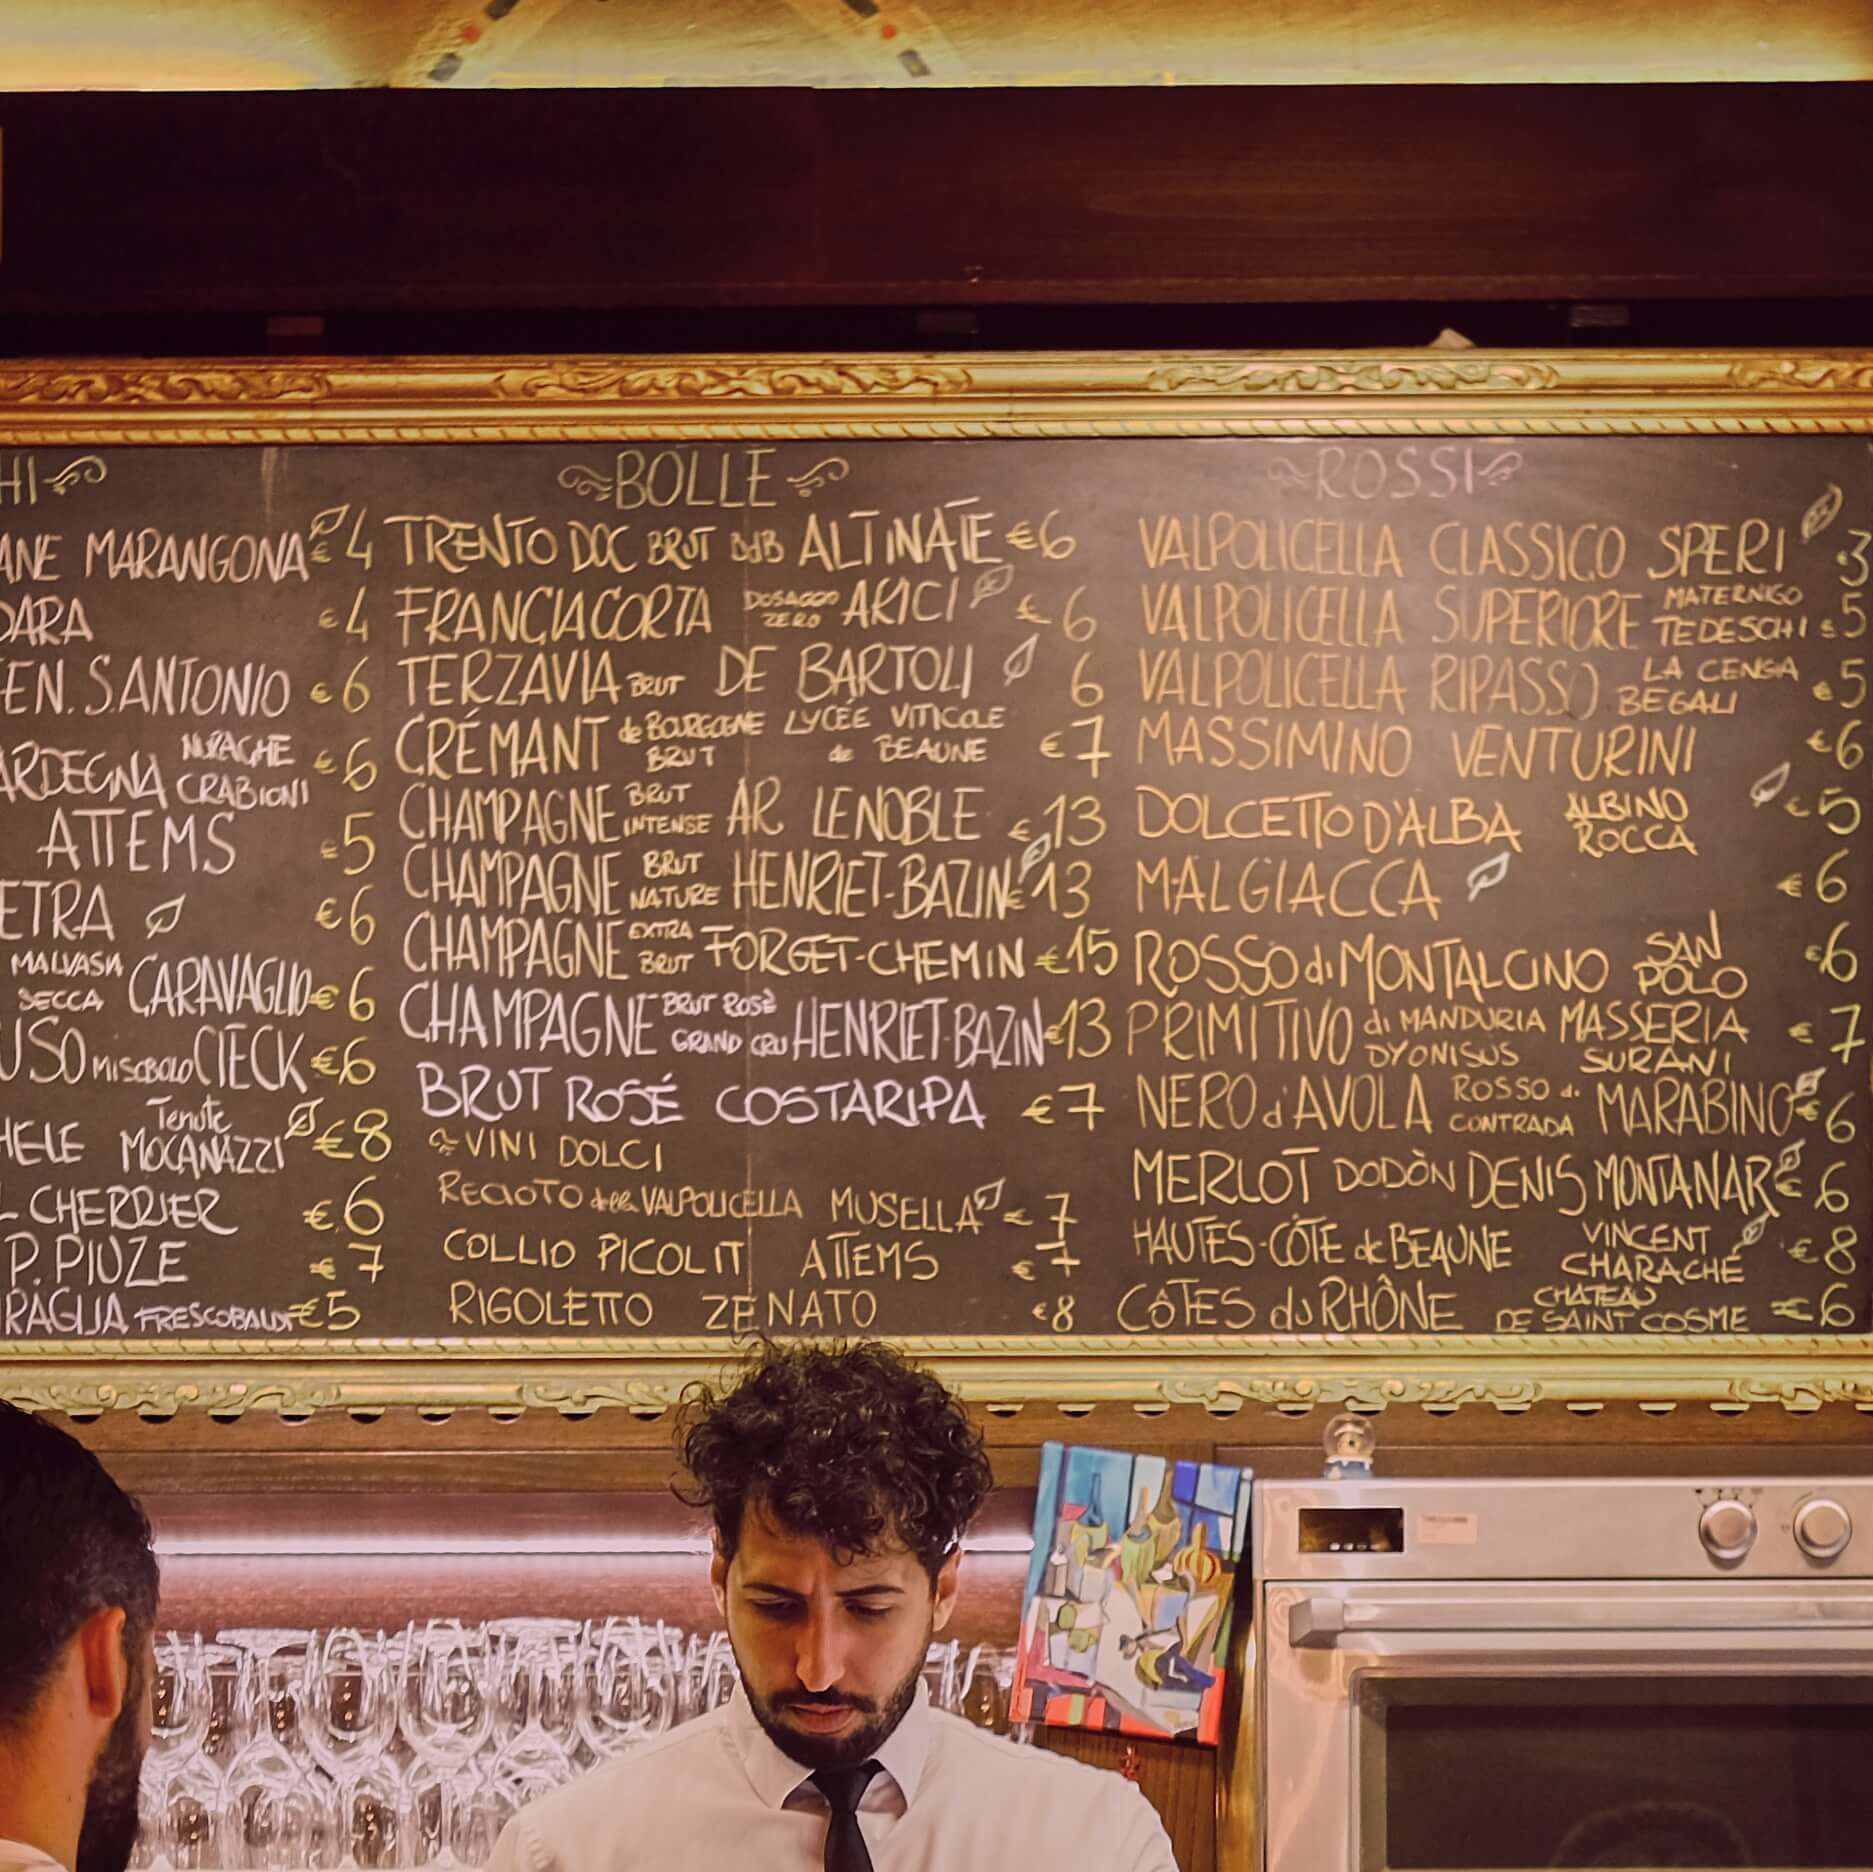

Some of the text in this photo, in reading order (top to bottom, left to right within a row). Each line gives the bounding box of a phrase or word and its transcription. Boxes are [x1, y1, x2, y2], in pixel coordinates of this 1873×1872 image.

[614, 448, 777, 509] BOLLE
[1314, 446, 1477, 499] ROSSI
[86, 529, 309, 582] MARANGONA
[383, 514, 557, 574] TRENTO
[567, 520, 637, 572] DOC
[647, 524, 717, 570] BRUT
[798, 496, 1003, 571] ALTINATE
[1138, 511, 1784, 582] VALPOLICELLA CLASSICO SPERI
[396, 578, 958, 649] FRANCIACORTA ZERO ARICI
[1140, 581, 1406, 646] VALPOLICELLA
[1430, 586, 1644, 651] SUPERIORE
[1652, 616, 1808, 645] TEDESCHI
[397, 642, 973, 708] TERZAVIA BRUT DE BARTOLI
[1138, 648, 1738, 716] VALPOLICELLA LA BEGALI
[394, 704, 988, 778] CRÉMANT BOURGOGNE BRUT BEAUNE
[1136, 718, 1697, 780] MASSIMINO VENTURINI
[398, 775, 987, 848] CHAMPAGNE BRUT INTENSE AR LENOBLE
[1136, 786, 1354, 848] DOLCETTO
[1564, 789, 1689, 822] ALBINO
[37, 808, 237, 875] ATTEMS
[1577, 825, 1697, 856] ROCCA
[400, 842, 722, 920] CHAMPAGNE BRUT NATURE
[1136, 858, 1442, 919] MALGIACCA
[403, 912, 694, 981] CHAMPAGNE EXTRA BRUT
[1136, 910, 1748, 1005] ROSSO MONTALCINO SAN POLO
[18, 986, 103, 1014] SECCA
[128, 952, 312, 1018] CARAVAGLIO
[398, 982, 790, 1059] CHAMPAGNE BRUT GRAND CRU
[1128, 999, 1749, 1076] PRIMITIVO di MANDURIA DYONISUS MASSERIA SURANI
[193, 1022, 308, 1095] CIECK
[418, 1062, 986, 1129] BRUT ROSÉ COSTARIPA
[1137, 1072, 1794, 1139] NERO ROSSO CONTRADA MARABINO
[464, 1130, 662, 1171] VINI DOLCI
[1133, 1146, 1780, 1218] MERLOT DENIS MONTANAR
[29, 1180, 238, 1236] CHERRIER
[640, 1185, 982, 1234] VALPOLICELLA MUSELLA
[56, 1236, 190, 1288] PIUZE
[442, 1229, 939, 1281] COLLIO PICOLIT ATTEMS
[1390, 1221, 1743, 1285] BEAUNE VINCENT CHARACHE
[449, 1281, 878, 1330] RIGOLETTO ZENATO
[1319, 1276, 1749, 1334] RHÔNE DE SAINT COSME
